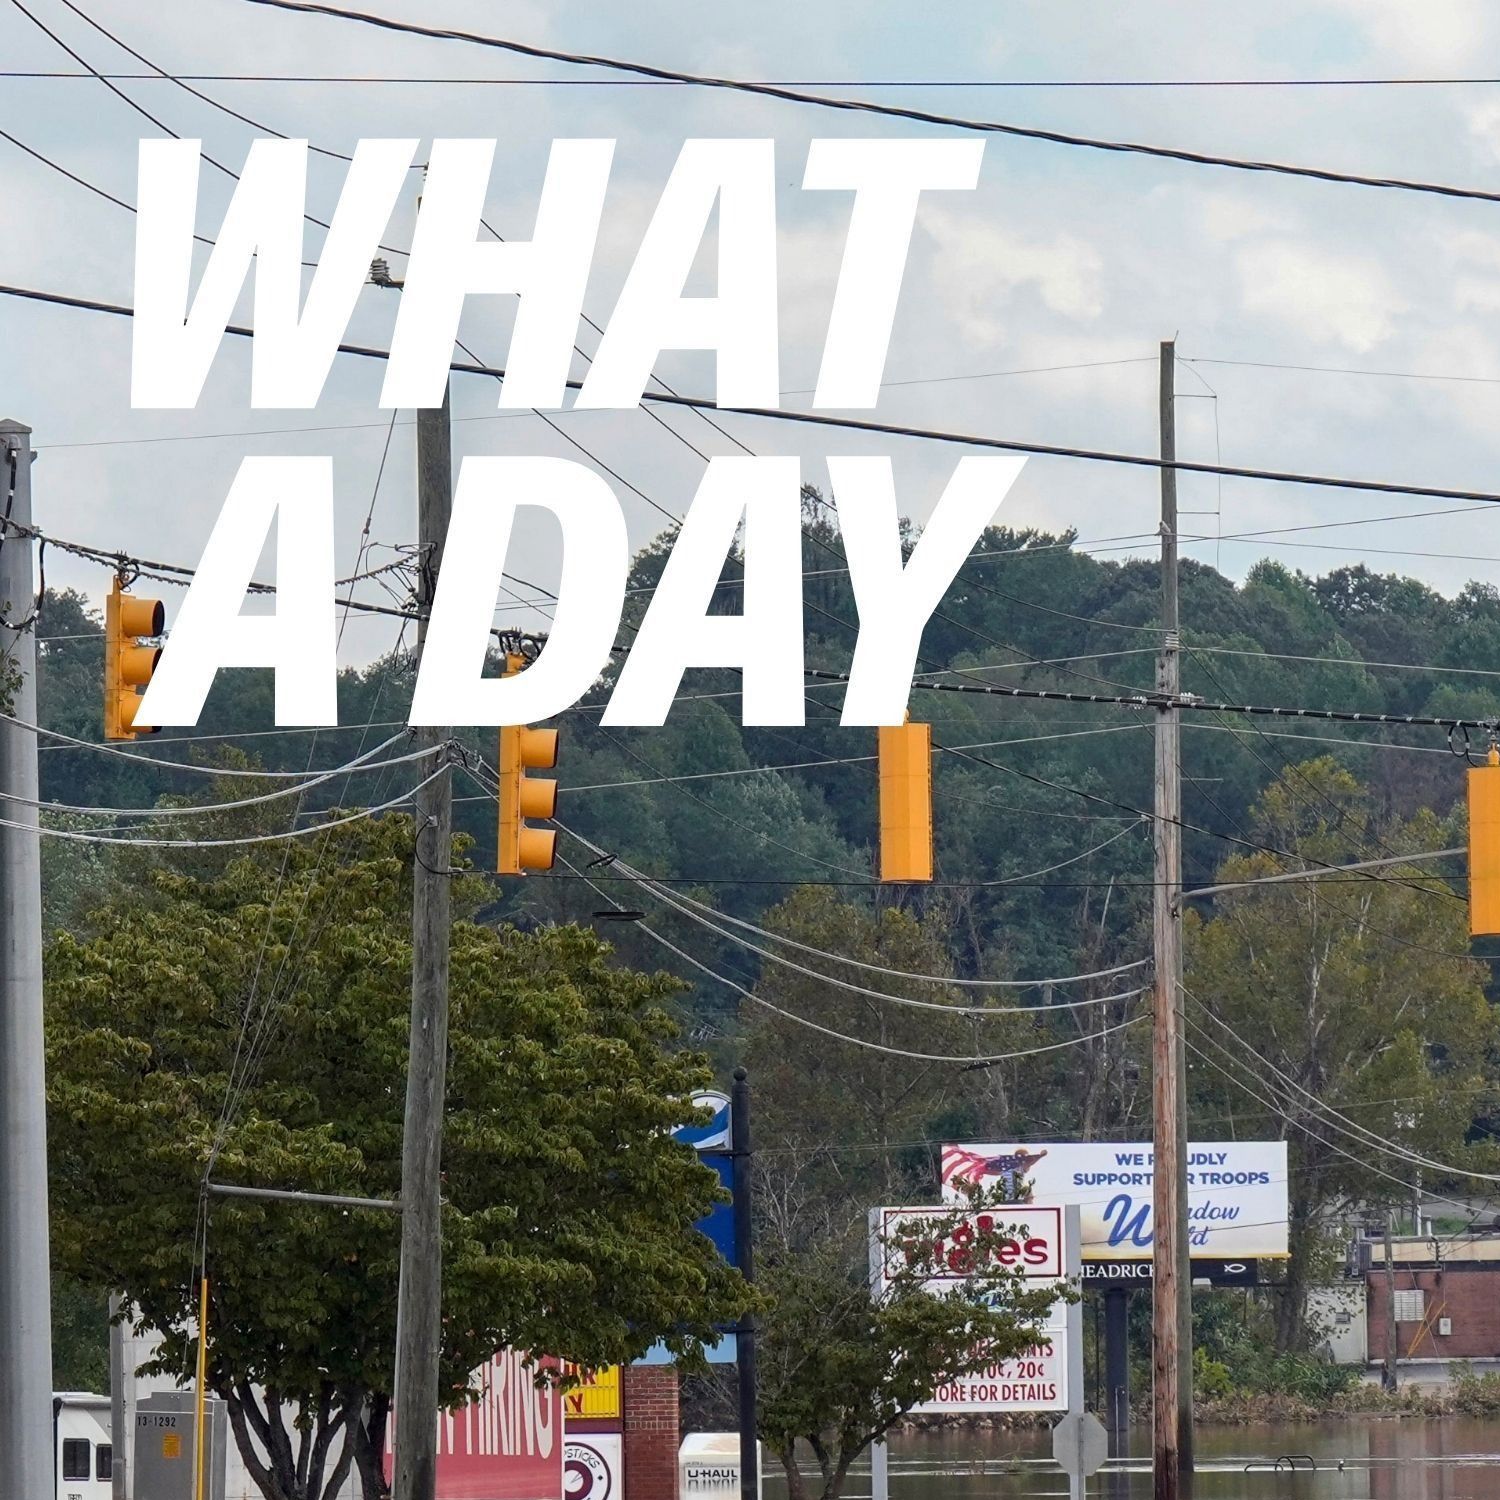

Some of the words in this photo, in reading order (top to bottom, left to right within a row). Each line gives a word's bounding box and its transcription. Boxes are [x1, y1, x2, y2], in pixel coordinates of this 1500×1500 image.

[1115, 1154, 1143, 1166] WE
[1073, 1173, 1152, 1186] SUPPORT
[1201, 1172, 1270, 1185] TROOPS
[1017, 1362, 1044, 1379] 20¢
[970, 1384, 998, 1401] FOR
[1002, 1383, 1056, 1401] DETAILS
[137, 1416, 176, 1427] 13-1292
[563, 1448, 600, 1468] STICKS
